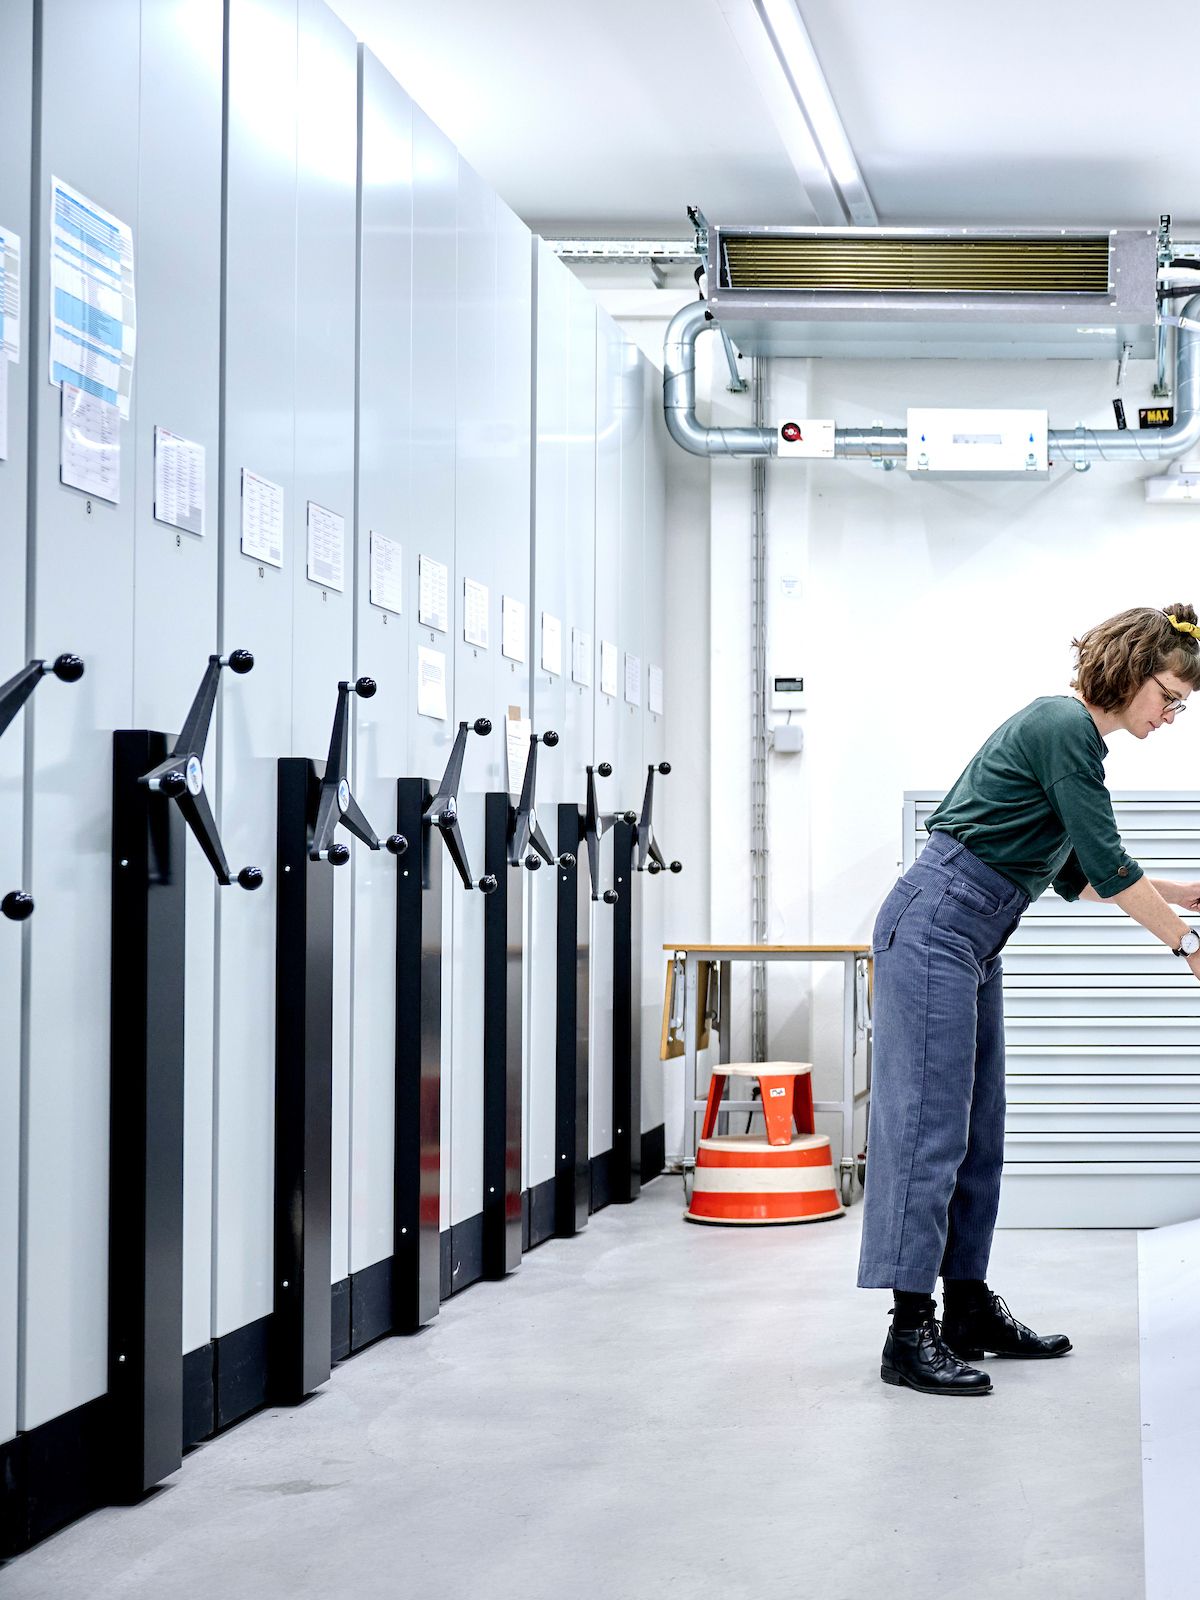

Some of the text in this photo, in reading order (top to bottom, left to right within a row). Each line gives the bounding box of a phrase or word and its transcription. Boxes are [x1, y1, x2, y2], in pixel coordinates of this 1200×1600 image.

[1147, 410, 1169, 421] MAX
[86, 501, 92, 514] 8
[175, 534, 181, 547] 9
[258, 567, 265, 578] 10
